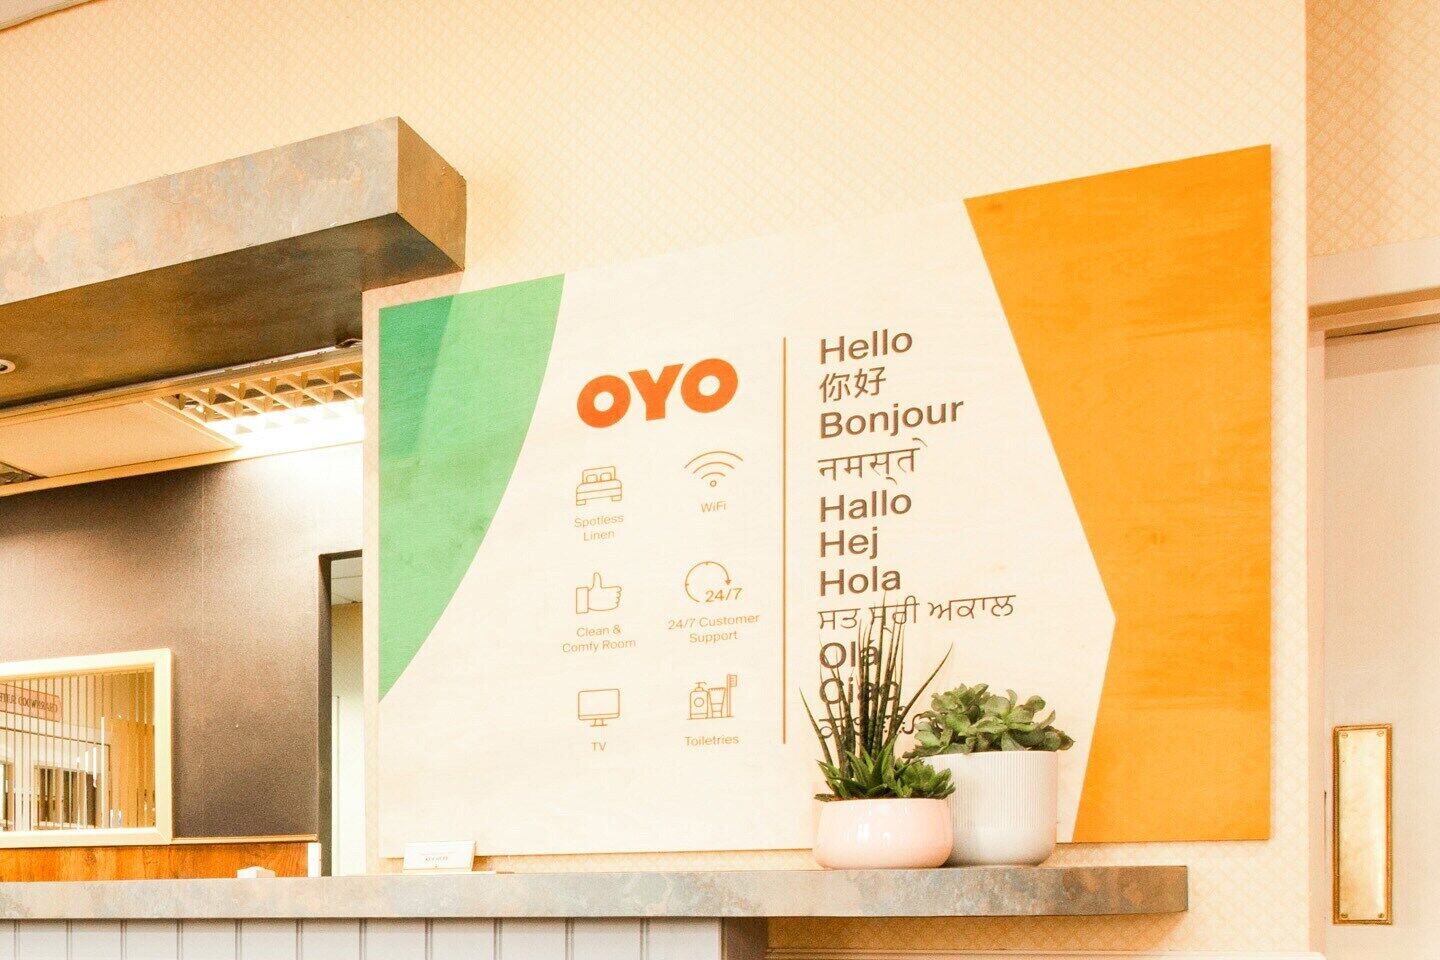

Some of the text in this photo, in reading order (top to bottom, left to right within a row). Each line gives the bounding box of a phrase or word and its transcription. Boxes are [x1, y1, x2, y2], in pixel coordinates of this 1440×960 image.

[820, 329, 913, 365] Hello
[819, 366, 887, 403] 你好
[577, 358, 739, 429] OYO
[820, 401, 965, 439] Bonjour
[701, 501, 727, 513] WiFi
[820, 490, 913, 522] Hallo
[574, 514, 624, 528] Spotless
[583, 530, 615, 541] Linen
[820, 526, 879, 560] Hej
[820, 566, 901, 596] Hola
[705, 587, 743, 604] 24/7
[818, 608, 861, 630] ਸਤ
[928, 595, 1017, 621] ਅਕਾਲ
[668, 614, 760, 630] 24/7 Customer
[576, 624, 622, 638] Clean &
[689, 630, 739, 644] Support
[562, 638, 636, 654] Comfy Room
[591, 741, 607, 752] TV
[685, 735, 740, 747] Toiletries
